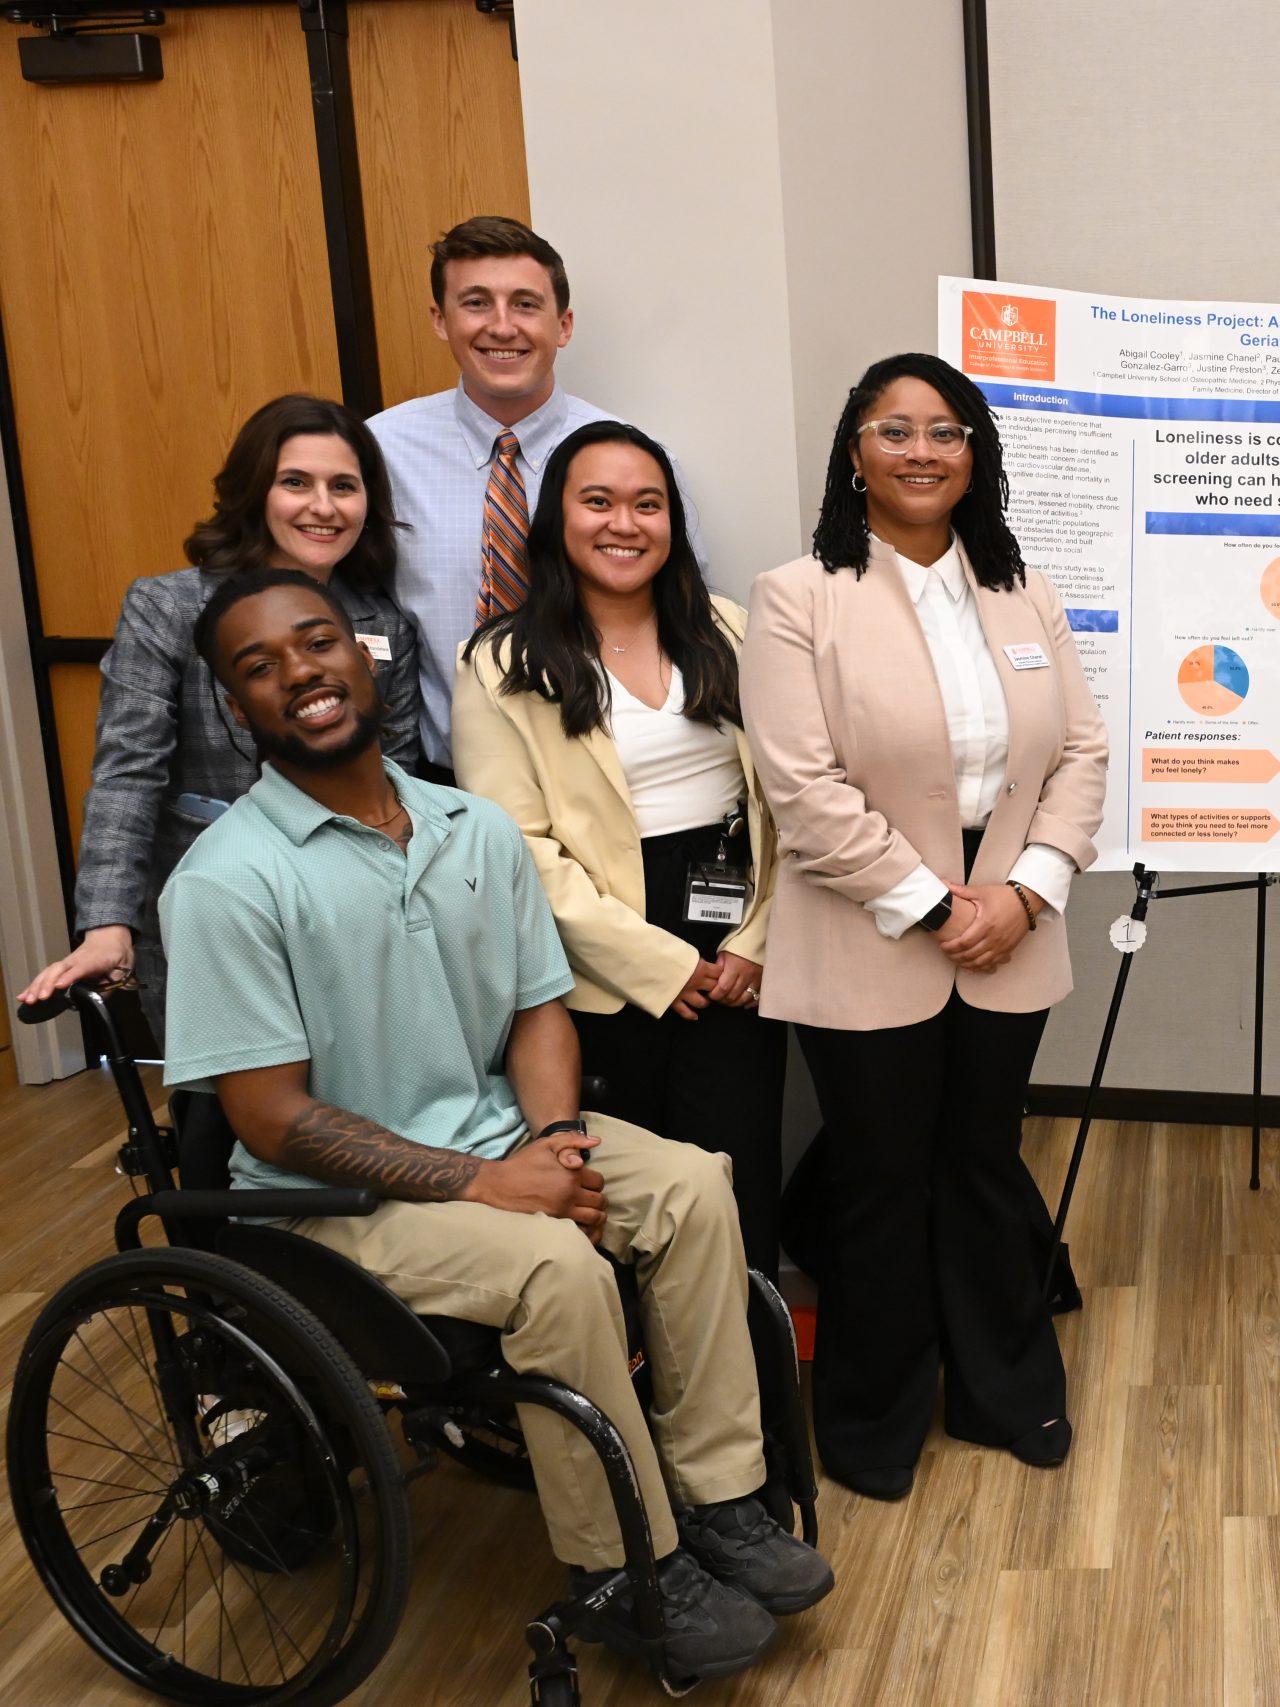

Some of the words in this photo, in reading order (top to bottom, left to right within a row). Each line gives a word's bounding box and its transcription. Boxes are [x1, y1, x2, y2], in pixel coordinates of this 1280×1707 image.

[1091, 306, 1117, 320] The
[1121, 309, 1202, 326] Loneliness
[1207, 313, 1263, 329] Project:
[970, 327, 1047, 345] CAMPBELL
[978, 342, 1040, 352] UNIVERSITY
[1119, 349, 1148, 361] Abigail
[1189, 352, 1224, 361] Jasmine
[1196, 364, 1227, 373] Justine
[1096, 371, 1125, 380] Campbell
[1127, 374, 1157, 383] University
[1190, 376, 1227, 385] Osteopathic
[1014, 392, 1068, 405] Introduction
[1019, 415, 1052, 425] subjective
[1053, 419, 1088, 428] experience
[1089, 421, 1102, 429] that
[1155, 429, 1243, 446] Loneliness
[1248, 432, 1261, 446] is
[1185, 451, 1226, 466] older
[1153, 471, 1233, 489] screening
[1237, 475, 1266, 487] can
[1195, 492, 1229, 507] who
[1234, 494, 1273, 507] need
[1145, 731, 1181, 740] Patient
[1184, 732, 1241, 742] responses:
[1216, 758, 1240, 766] makes
[1151, 767, 1165, 775] you
[1180, 767, 1207, 775] lonely?
[1170, 813, 1189, 822] types
[1241, 814, 1271, 822] supports
